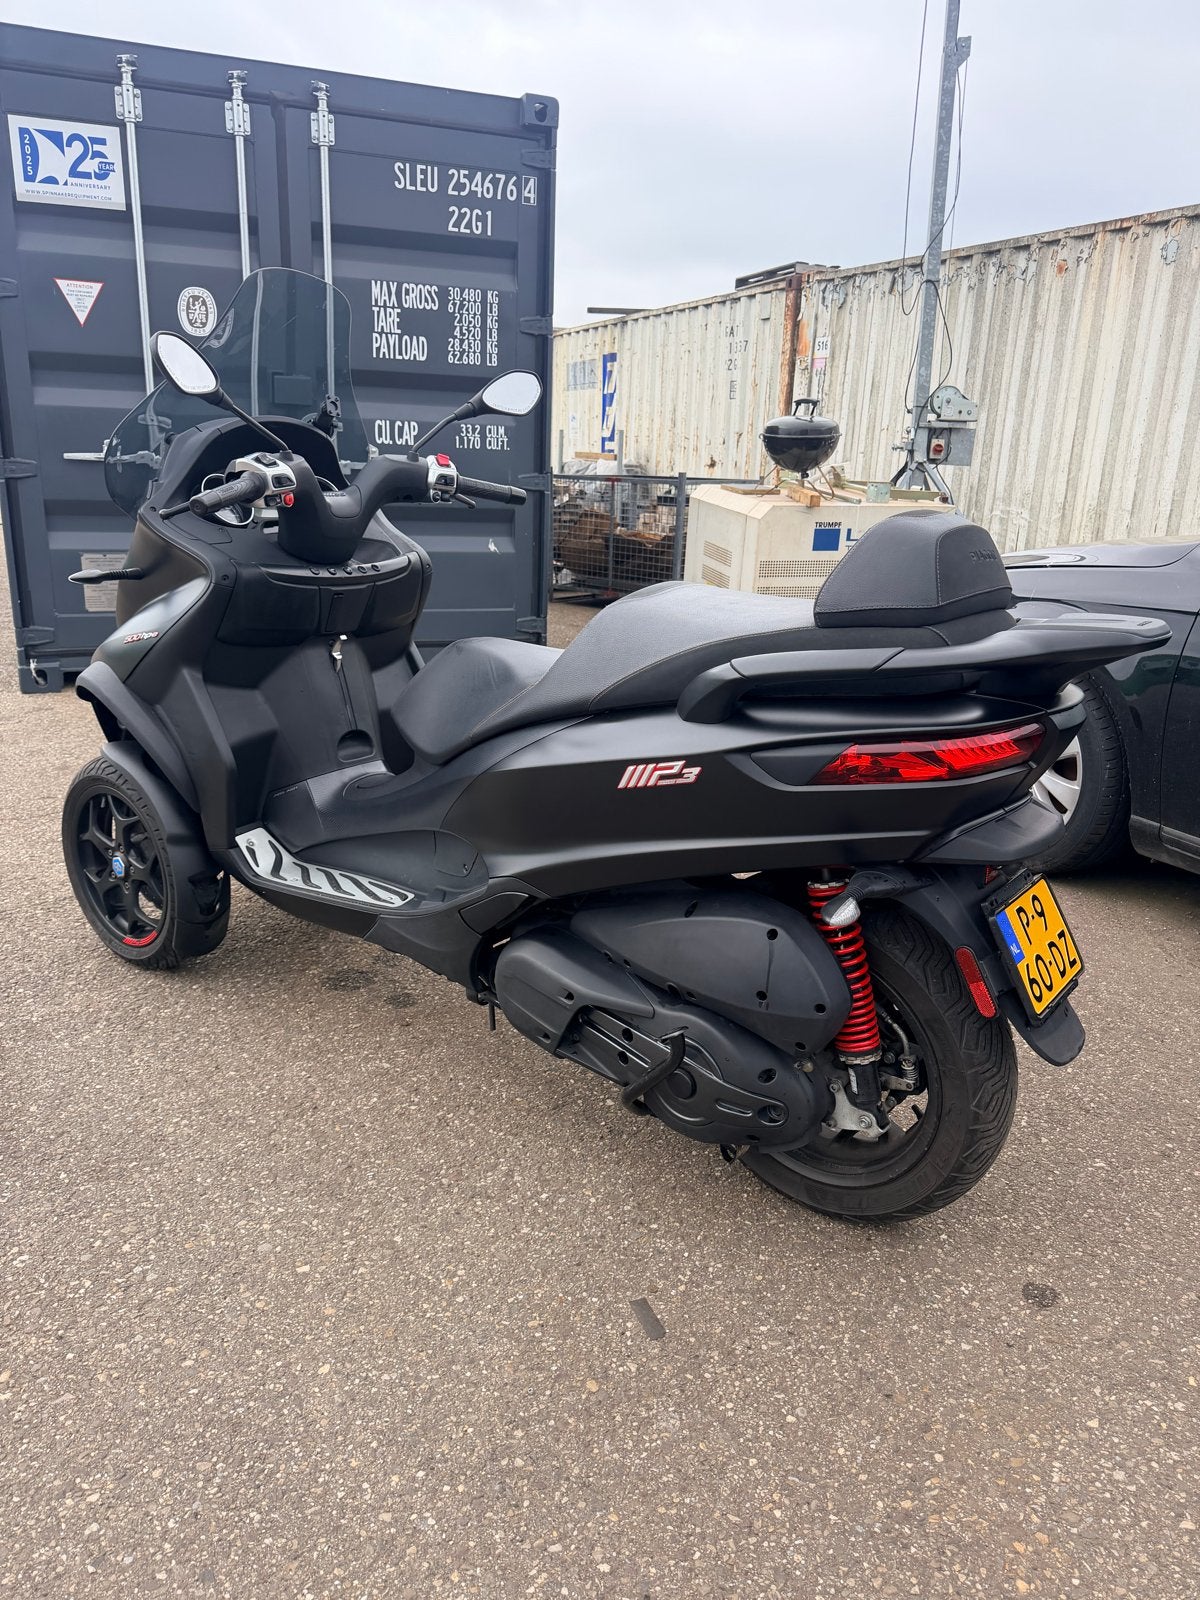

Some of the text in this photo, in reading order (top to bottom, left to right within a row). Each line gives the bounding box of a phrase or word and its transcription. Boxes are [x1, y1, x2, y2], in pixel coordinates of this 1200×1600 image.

[24, 134, 33, 176] 2025
[98, 163, 114, 172] YEAR
[70, 182, 111, 190] ANNIVERSARY
[394, 162, 536, 204] SLEU 254676 4
[448, 206, 492, 236] 22G1
[372, 280, 499, 310] MAX GROSS 30.480 KG
[448, 300, 499, 316] 67.200 LB
[372, 307, 498, 334] TARE 2.050 KG
[454, 327, 498, 342] 4.520 LB
[372, 332, 498, 362] PAYLOAD 28.430 KG
[817, 340, 828, 351] 516
[448, 352, 498, 366] 62.680 LB
[460, 424, 480, 436] 33.2
[456, 436, 480, 450] 1.170
[617, 760, 702, 789] MP3
[1010, 943, 1020, 956] NL
[1025, 929, 1078, 1004] 60-DZ
